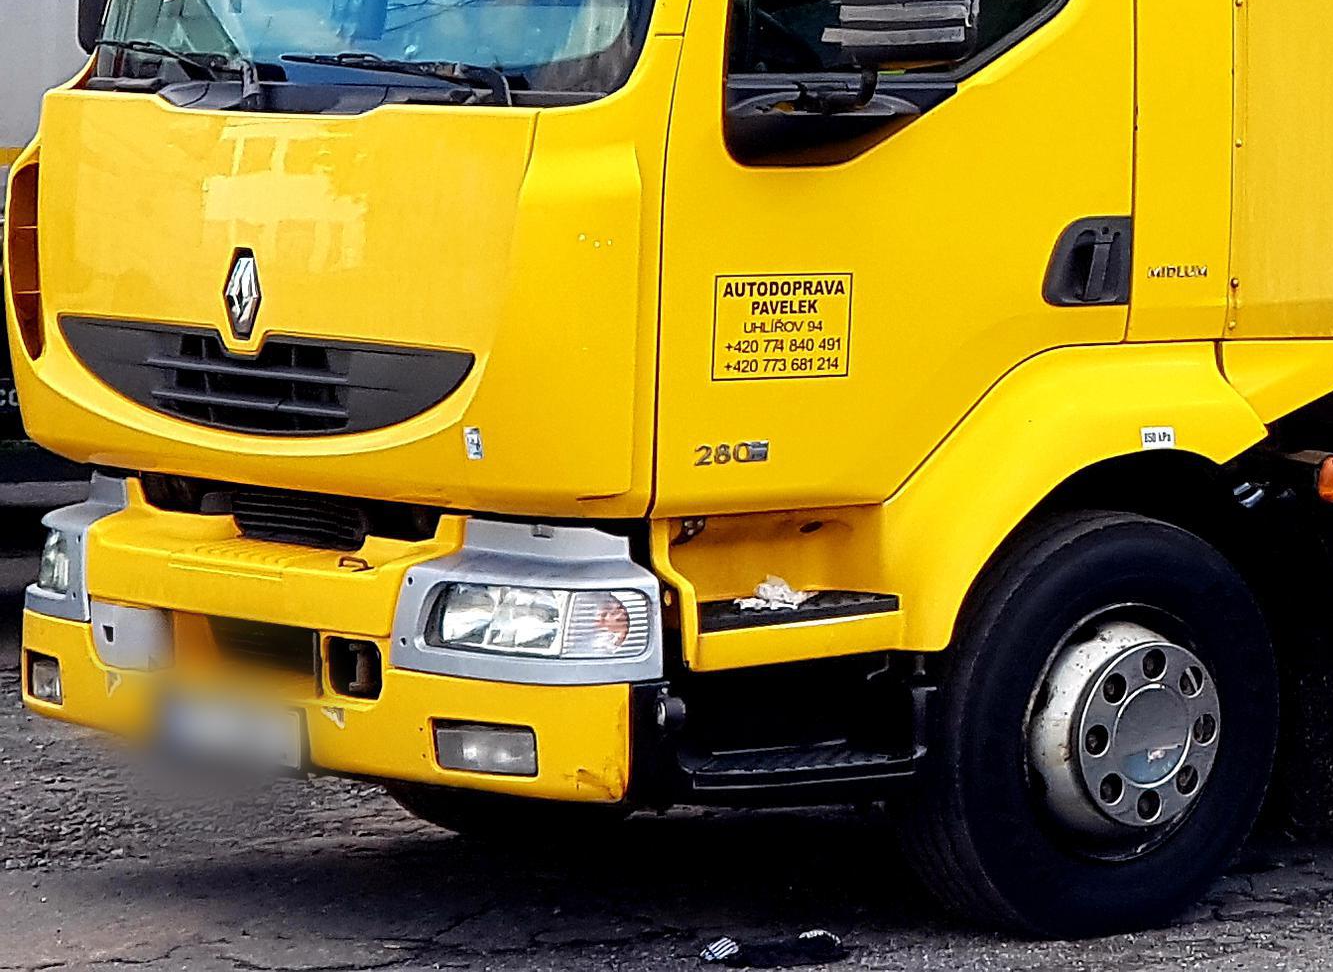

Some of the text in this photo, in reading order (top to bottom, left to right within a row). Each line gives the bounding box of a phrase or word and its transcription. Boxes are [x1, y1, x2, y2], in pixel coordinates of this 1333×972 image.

[1147, 265, 1207, 278] MIDLUM
[723, 280, 846, 298] AUTODOPRAVA
[751, 299, 818, 316] PAVELEK
[743, 318, 824, 334] UHLÍŘOV 94
[725, 337, 842, 354] +420 774 840 491
[724, 357, 839, 373] +420 773 681 214
[694, 442, 750, 467] 280
